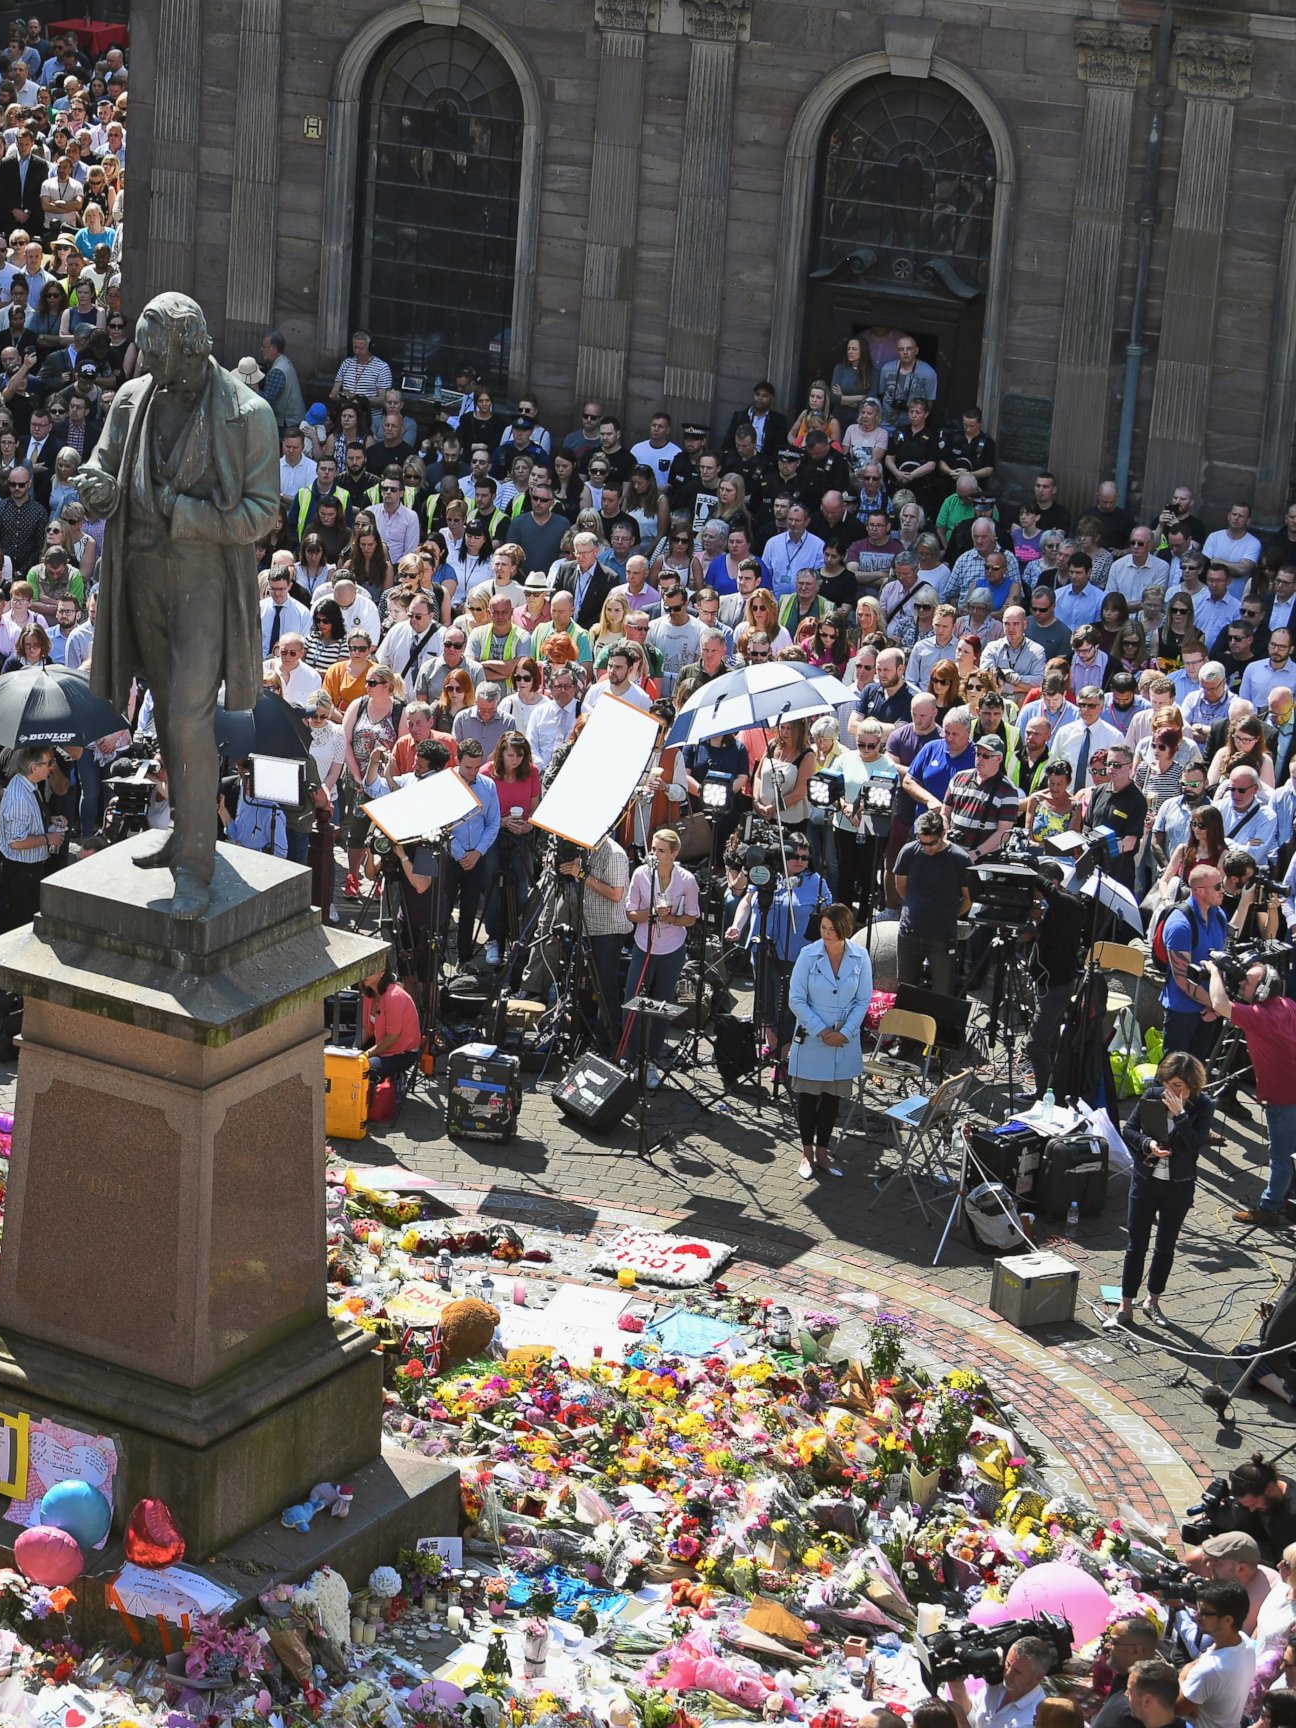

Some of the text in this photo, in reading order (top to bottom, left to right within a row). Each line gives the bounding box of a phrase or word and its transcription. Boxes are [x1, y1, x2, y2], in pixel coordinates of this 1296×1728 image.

[30, 732, 76, 741] DUNLOP
[806, 1256, 891, 1289] LOVE
[906, 1291, 969, 1324] ONE
[1066, 1386, 1160, 1447] SUPPORT
